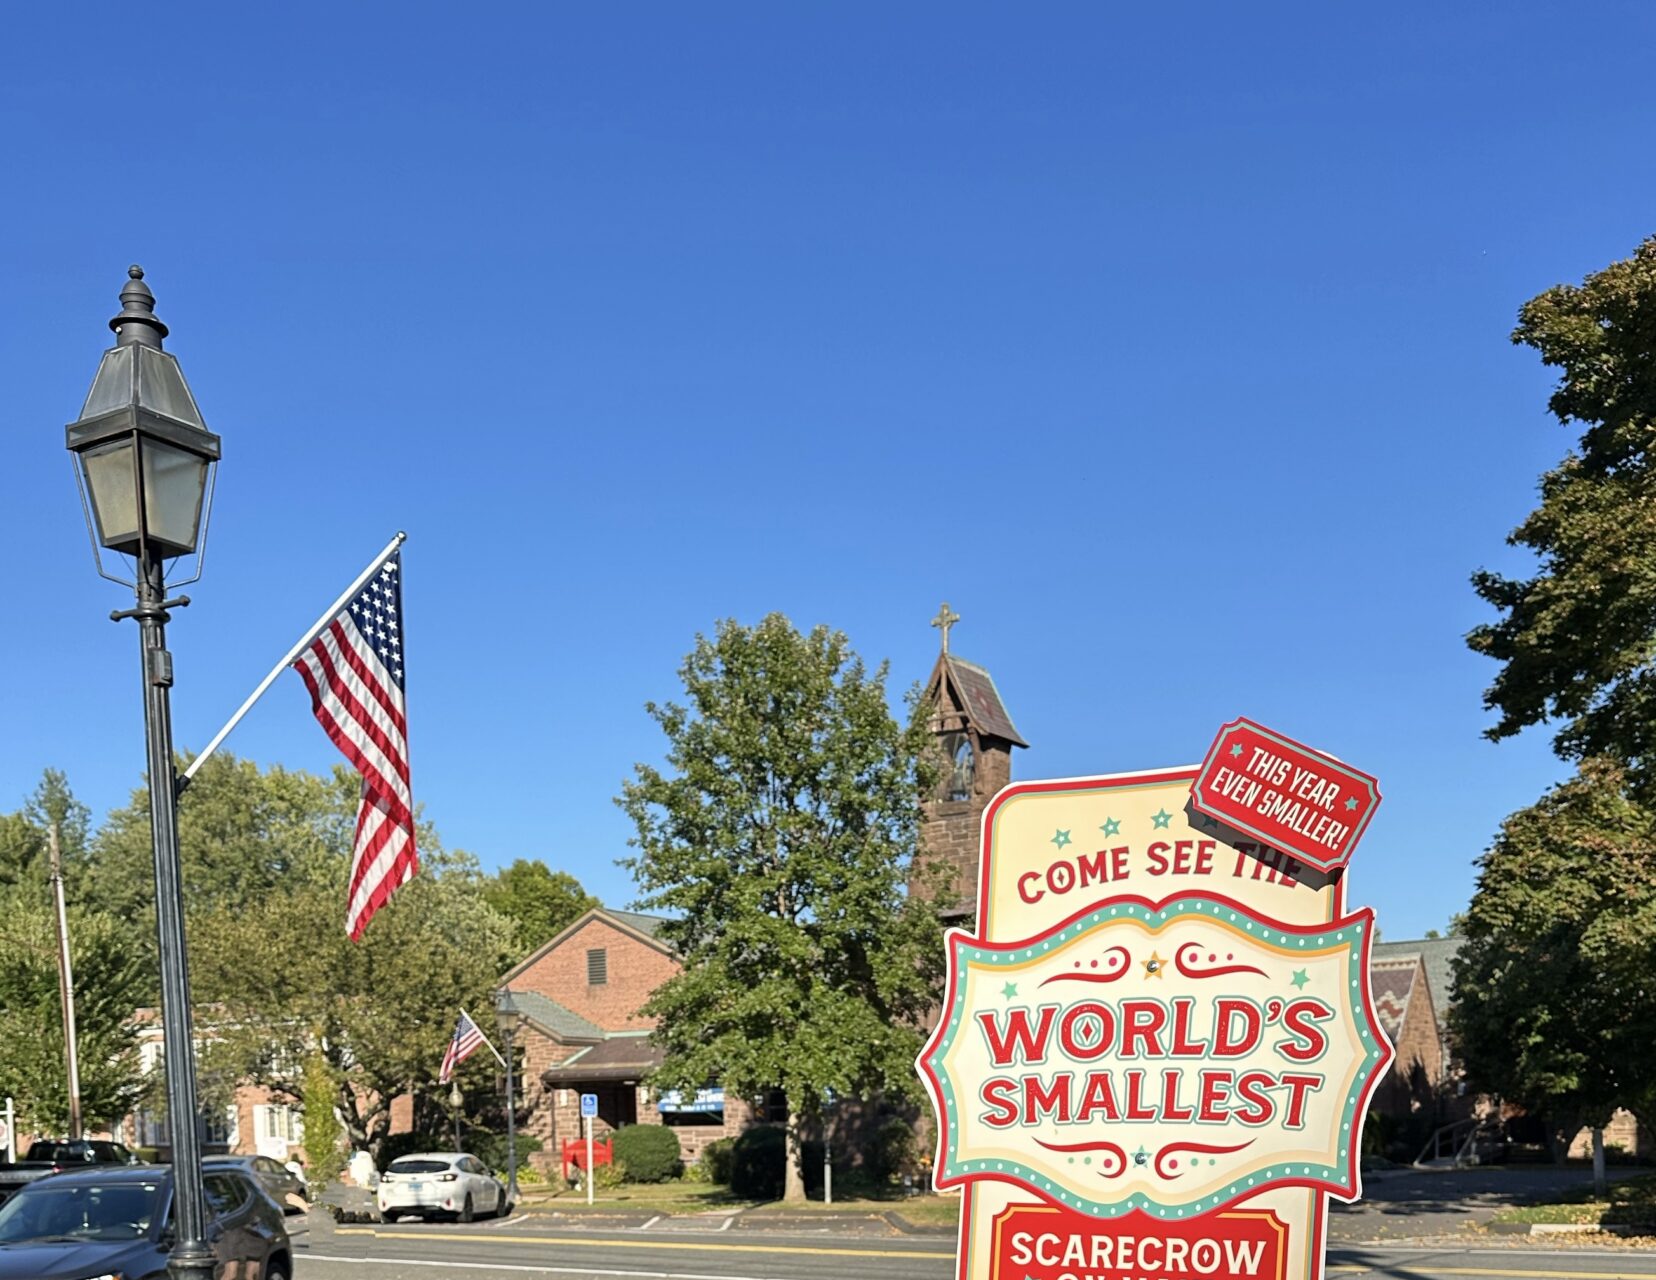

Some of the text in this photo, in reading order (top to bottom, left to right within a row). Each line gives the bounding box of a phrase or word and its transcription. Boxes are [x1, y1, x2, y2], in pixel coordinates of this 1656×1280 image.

[1210, 767, 1349, 850] EVEN SMALLER!
[1246, 747, 1340, 812] THIS YEAR,
[1017, 846, 1130, 904] COME
[1145, 840, 1216, 876] SEE
[977, 997, 1334, 1066] WORLD'S
[981, 1069, 1322, 1129] SMALLEST
[1010, 1232, 1267, 1275] SCARECROW
